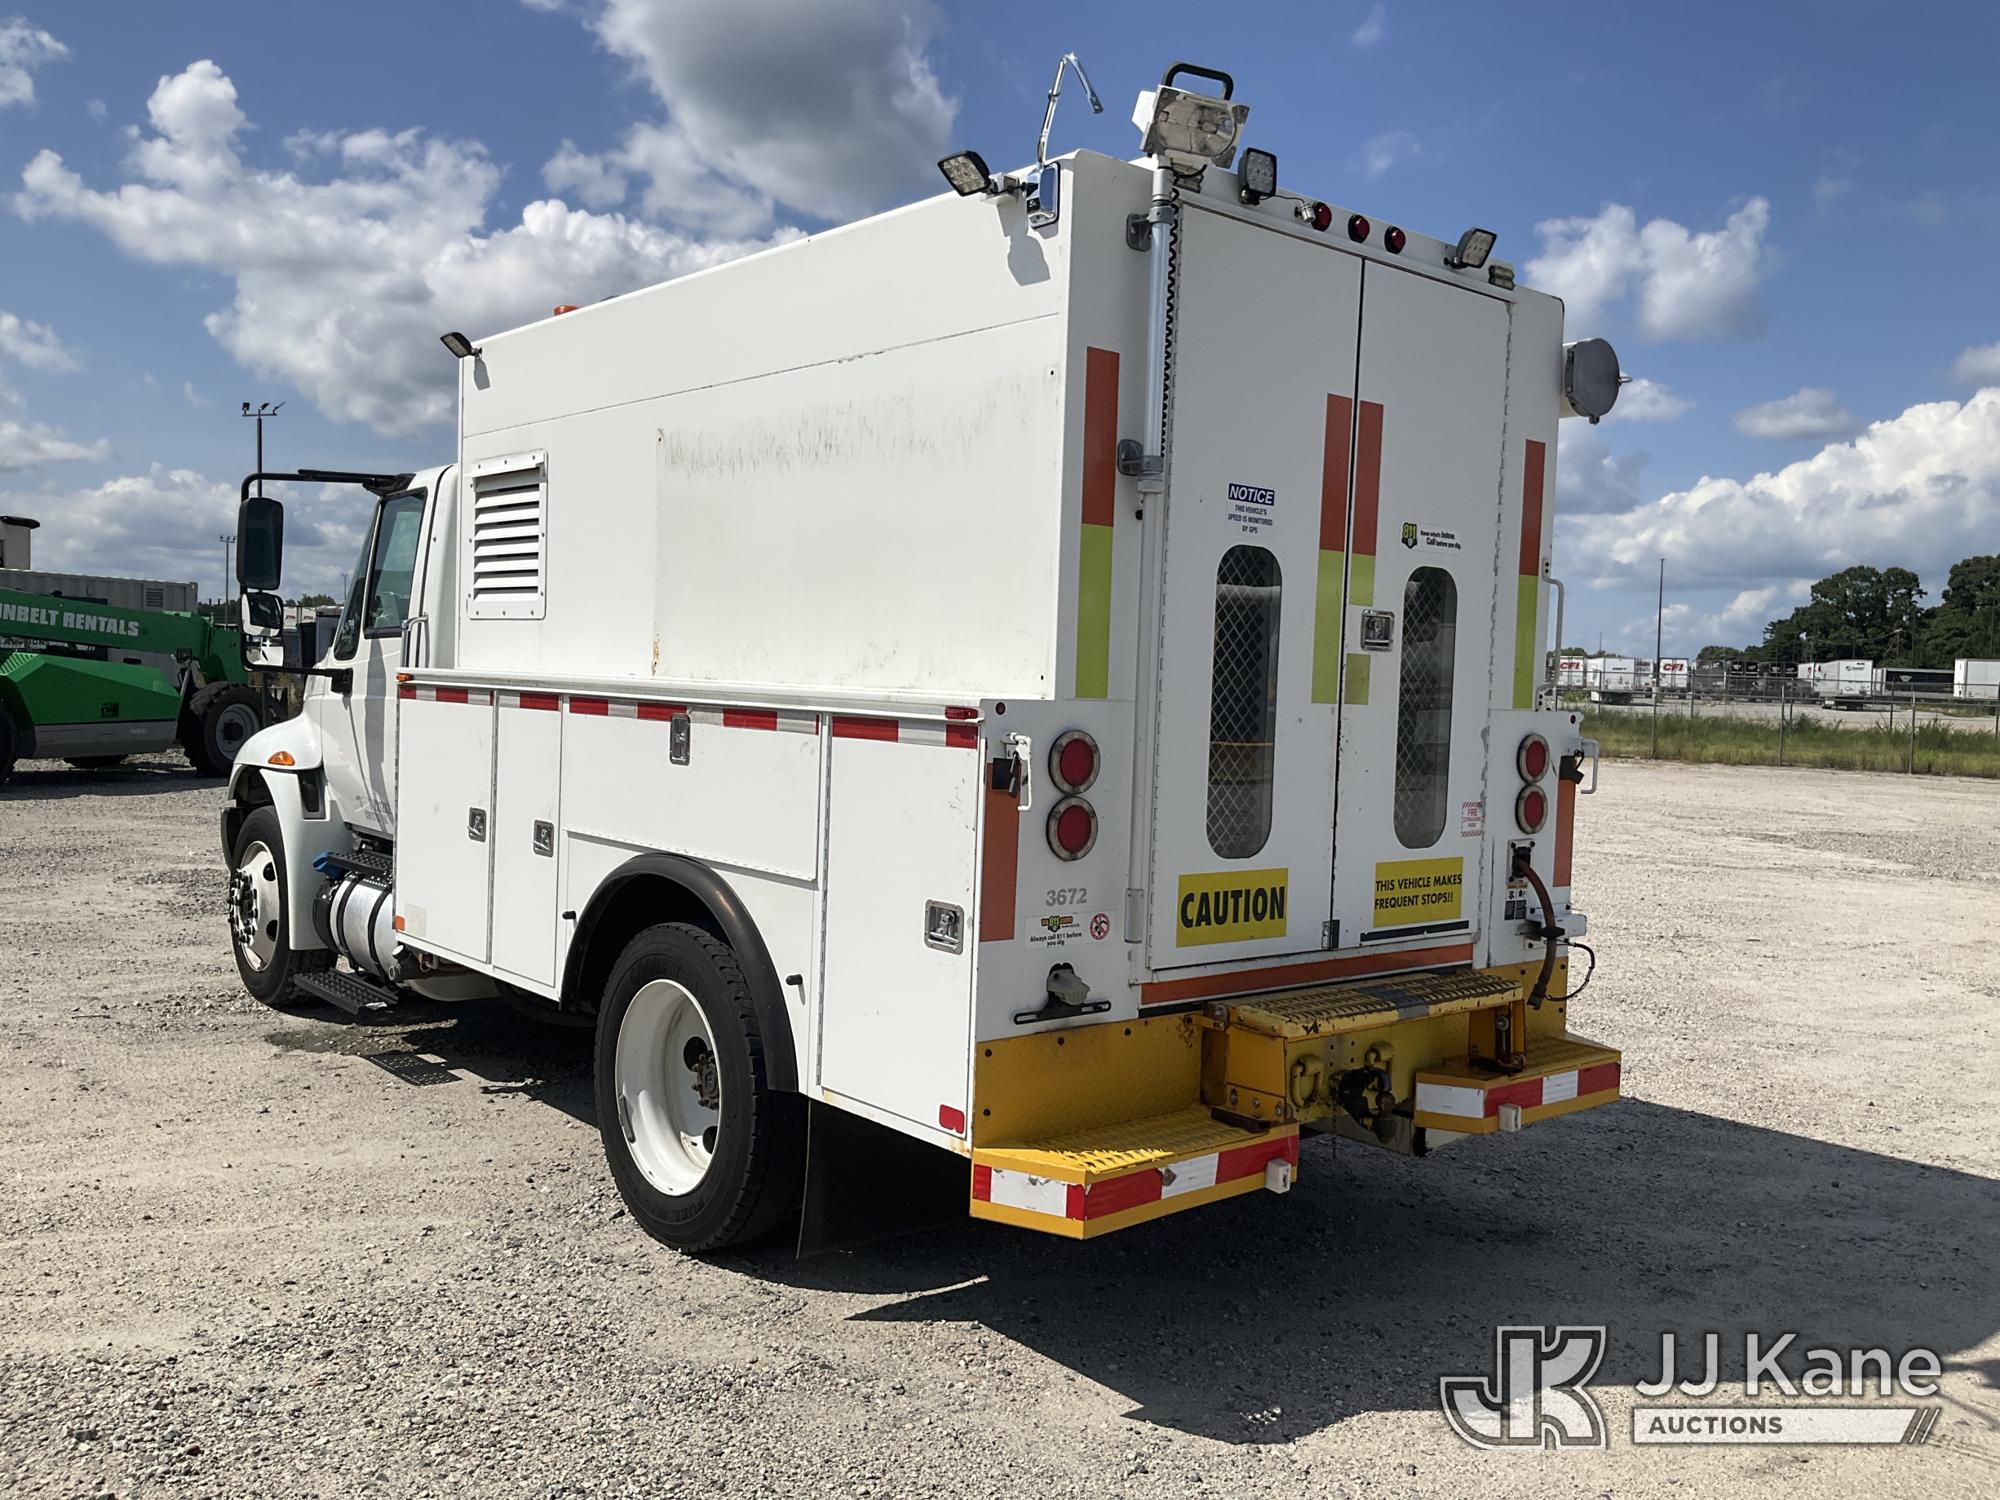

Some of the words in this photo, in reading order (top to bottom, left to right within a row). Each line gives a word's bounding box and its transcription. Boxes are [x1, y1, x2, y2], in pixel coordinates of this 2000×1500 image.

[1230, 485, 1274, 505] NOTICE
[1403, 523, 1417, 540] 811
[0, 603, 59, 626] NBELT
[63, 612, 139, 637] RENTALS
[1560, 662, 1580, 670] CFI
[1663, 663, 1684, 671] CFI
[1376, 879, 1395, 892] THIS
[1397, 877, 1431, 890] VEHICLE
[1433, 874, 1462, 887] MAKES
[1046, 888, 1087, 906] 3672
[1375, 895, 1419, 909] FREQUENT
[1421, 892, 1454, 905] STOPS!!
[1181, 887, 1285, 928] CAUTION
[1030, 935, 1047, 943] Always
[1066, 931, 1082, 939] before
